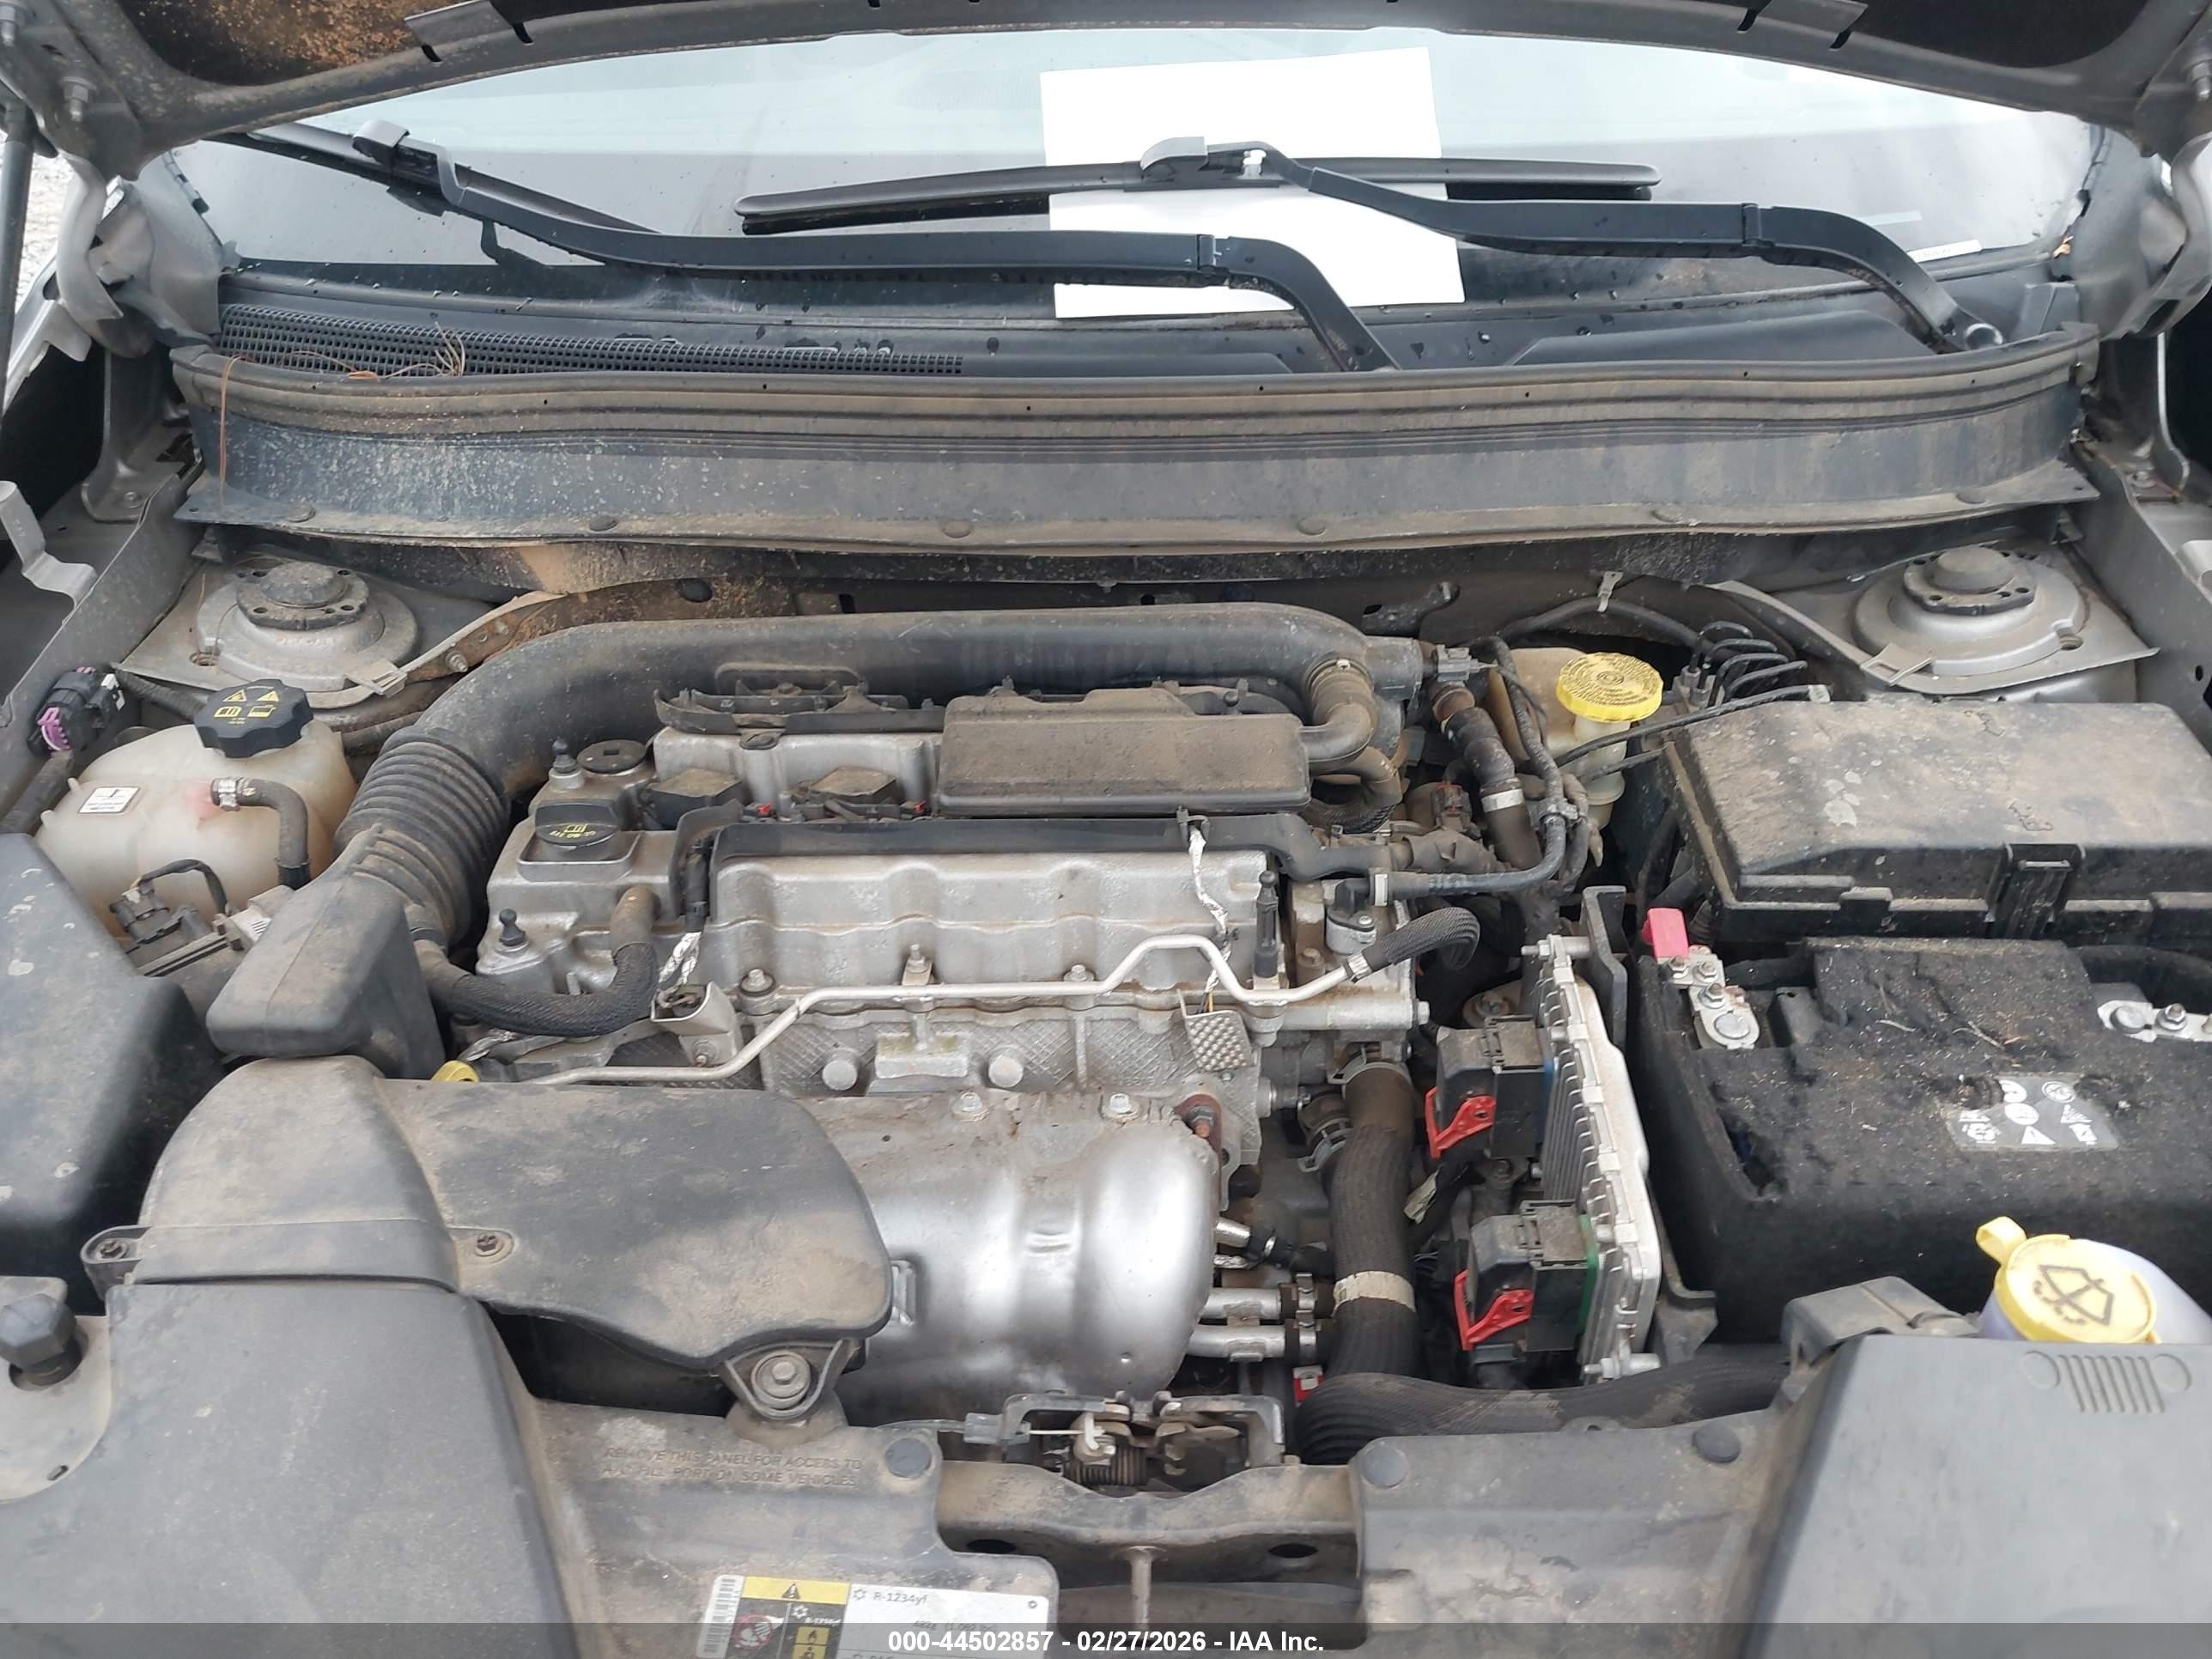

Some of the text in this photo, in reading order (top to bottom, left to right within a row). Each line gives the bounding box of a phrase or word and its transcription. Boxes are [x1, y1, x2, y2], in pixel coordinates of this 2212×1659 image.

[670, 1449, 701, 1462] THIS
[708, 1452, 749, 1465] PANEL
[754, 1454, 780, 1467] FOR
[844, 1458, 861, 1471] TO
[672, 1468, 712, 1481] PORT
[873, 1591, 928, 1606] R-1234yf
